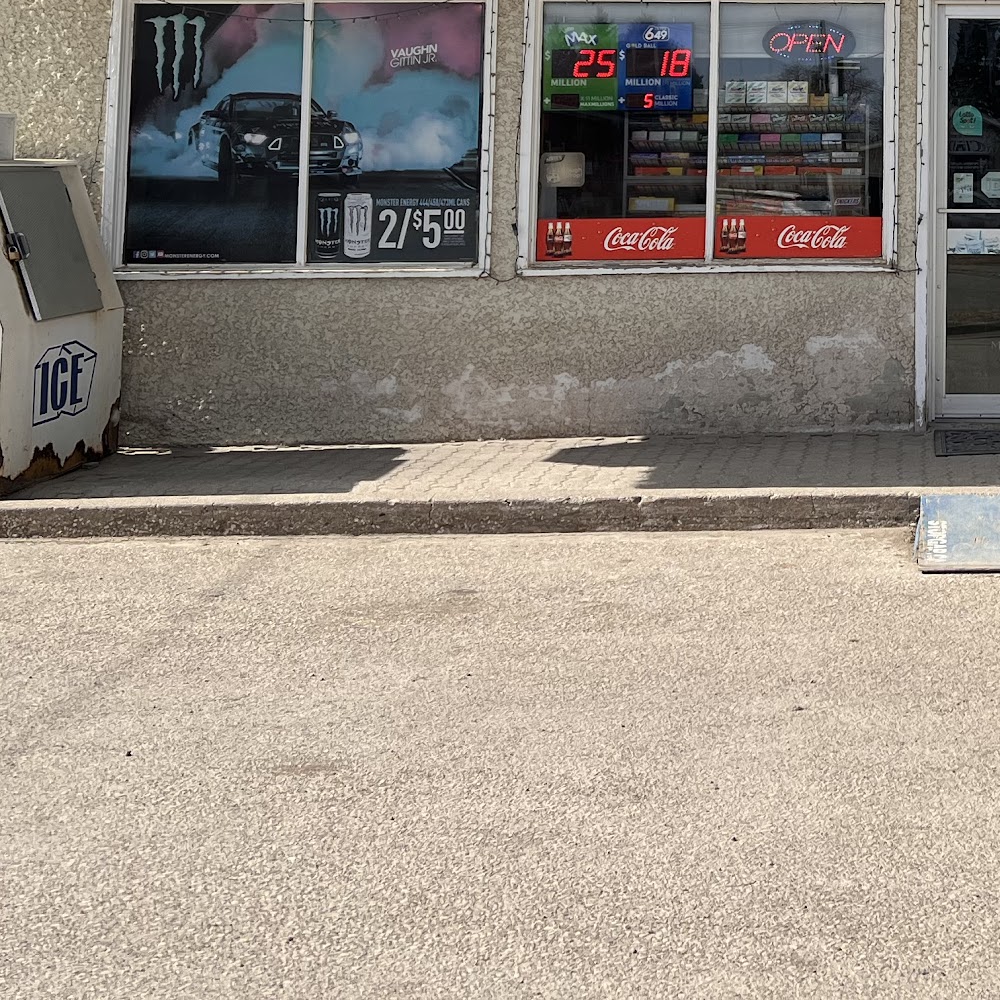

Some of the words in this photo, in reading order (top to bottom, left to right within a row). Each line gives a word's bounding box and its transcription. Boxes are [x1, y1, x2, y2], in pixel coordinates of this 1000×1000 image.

[390, 43, 438, 58] VAUGHN
[769, 31, 846, 53] OPEN
[572, 49, 616, 78] 25
[660, 49, 692, 77] 18
[550, 78, 587, 87] MILLION
[625, 78, 661, 87] MILLION
[643, 93, 654, 109] 5
[376, 198, 399, 206] MONSTER
[400, 198, 419, 206] ENERGY
[456, 198, 470, 207] CANS
[603, 226, 679, 251] Coca-Cola
[777, 224, 852, 249] Coca-Cola
[39, 352, 85, 416] ICE
